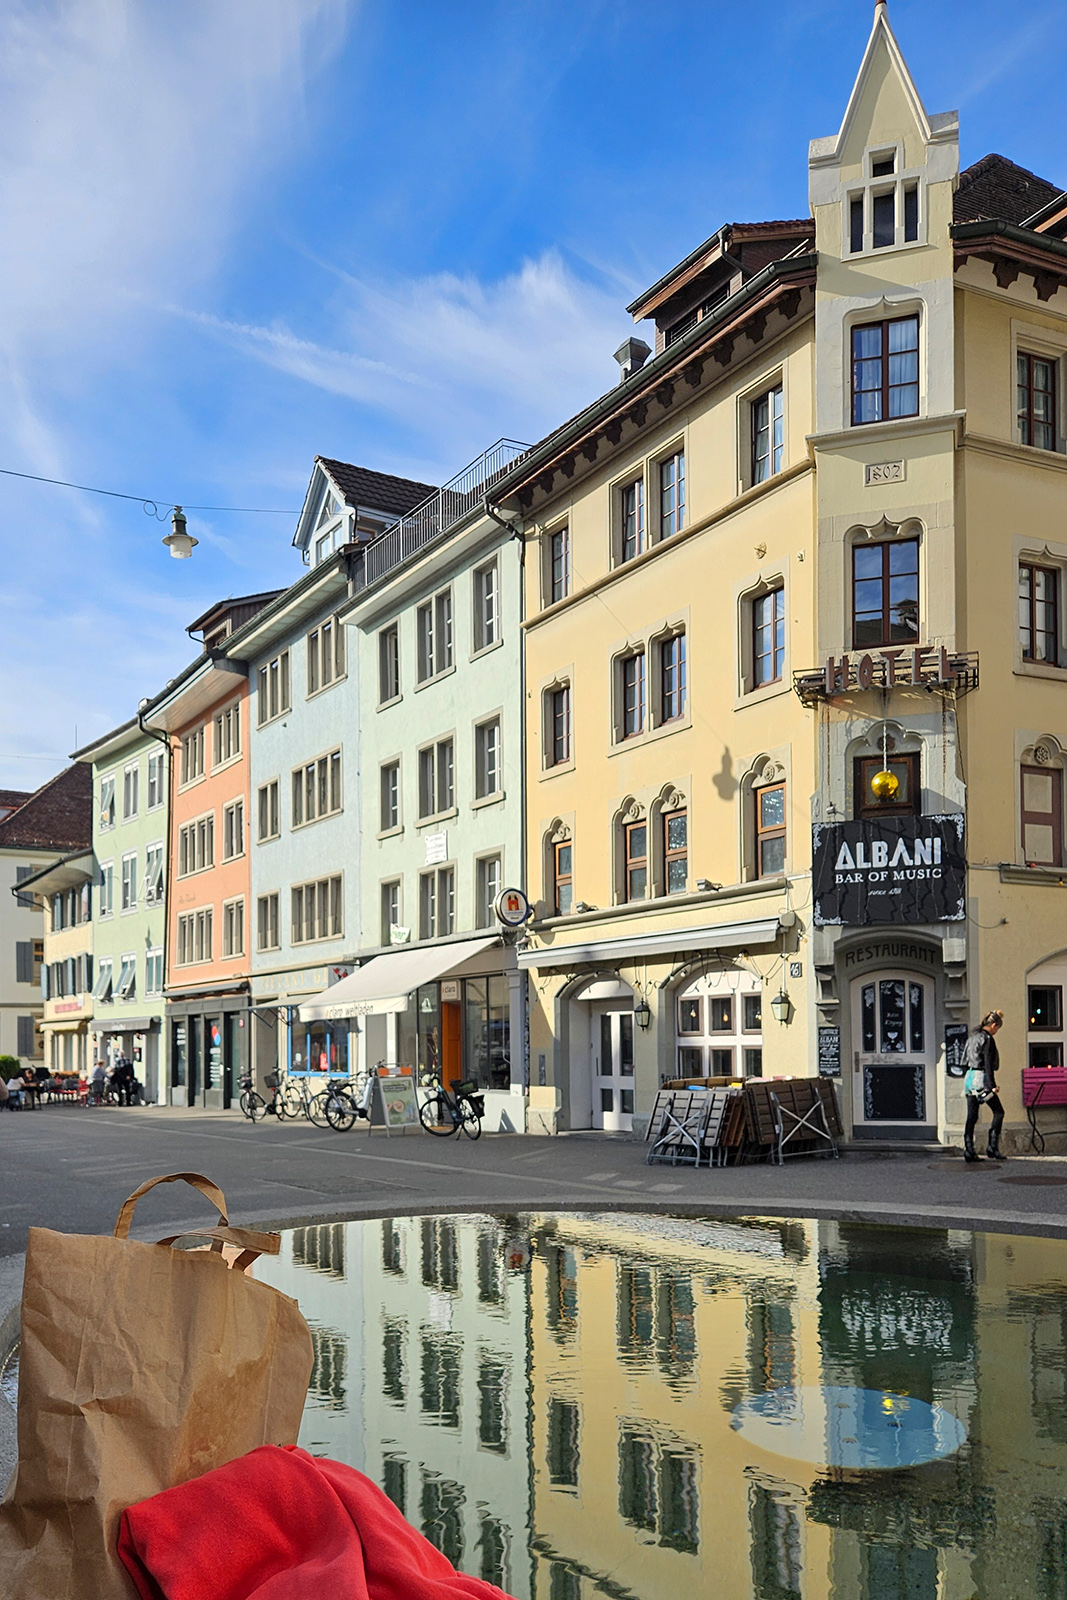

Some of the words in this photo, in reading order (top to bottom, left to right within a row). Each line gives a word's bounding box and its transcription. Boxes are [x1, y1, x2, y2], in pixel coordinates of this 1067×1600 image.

[826, 645, 958, 693] HOTEL
[835, 837, 942, 870] ALBANI
[835, 872, 865, 884] BAR
[868, 871, 889, 882] OF
[893, 868, 942, 881] MUSIC
[845, 943, 936, 968] RESTAURANT
[328, 1005, 344, 1018] claro
